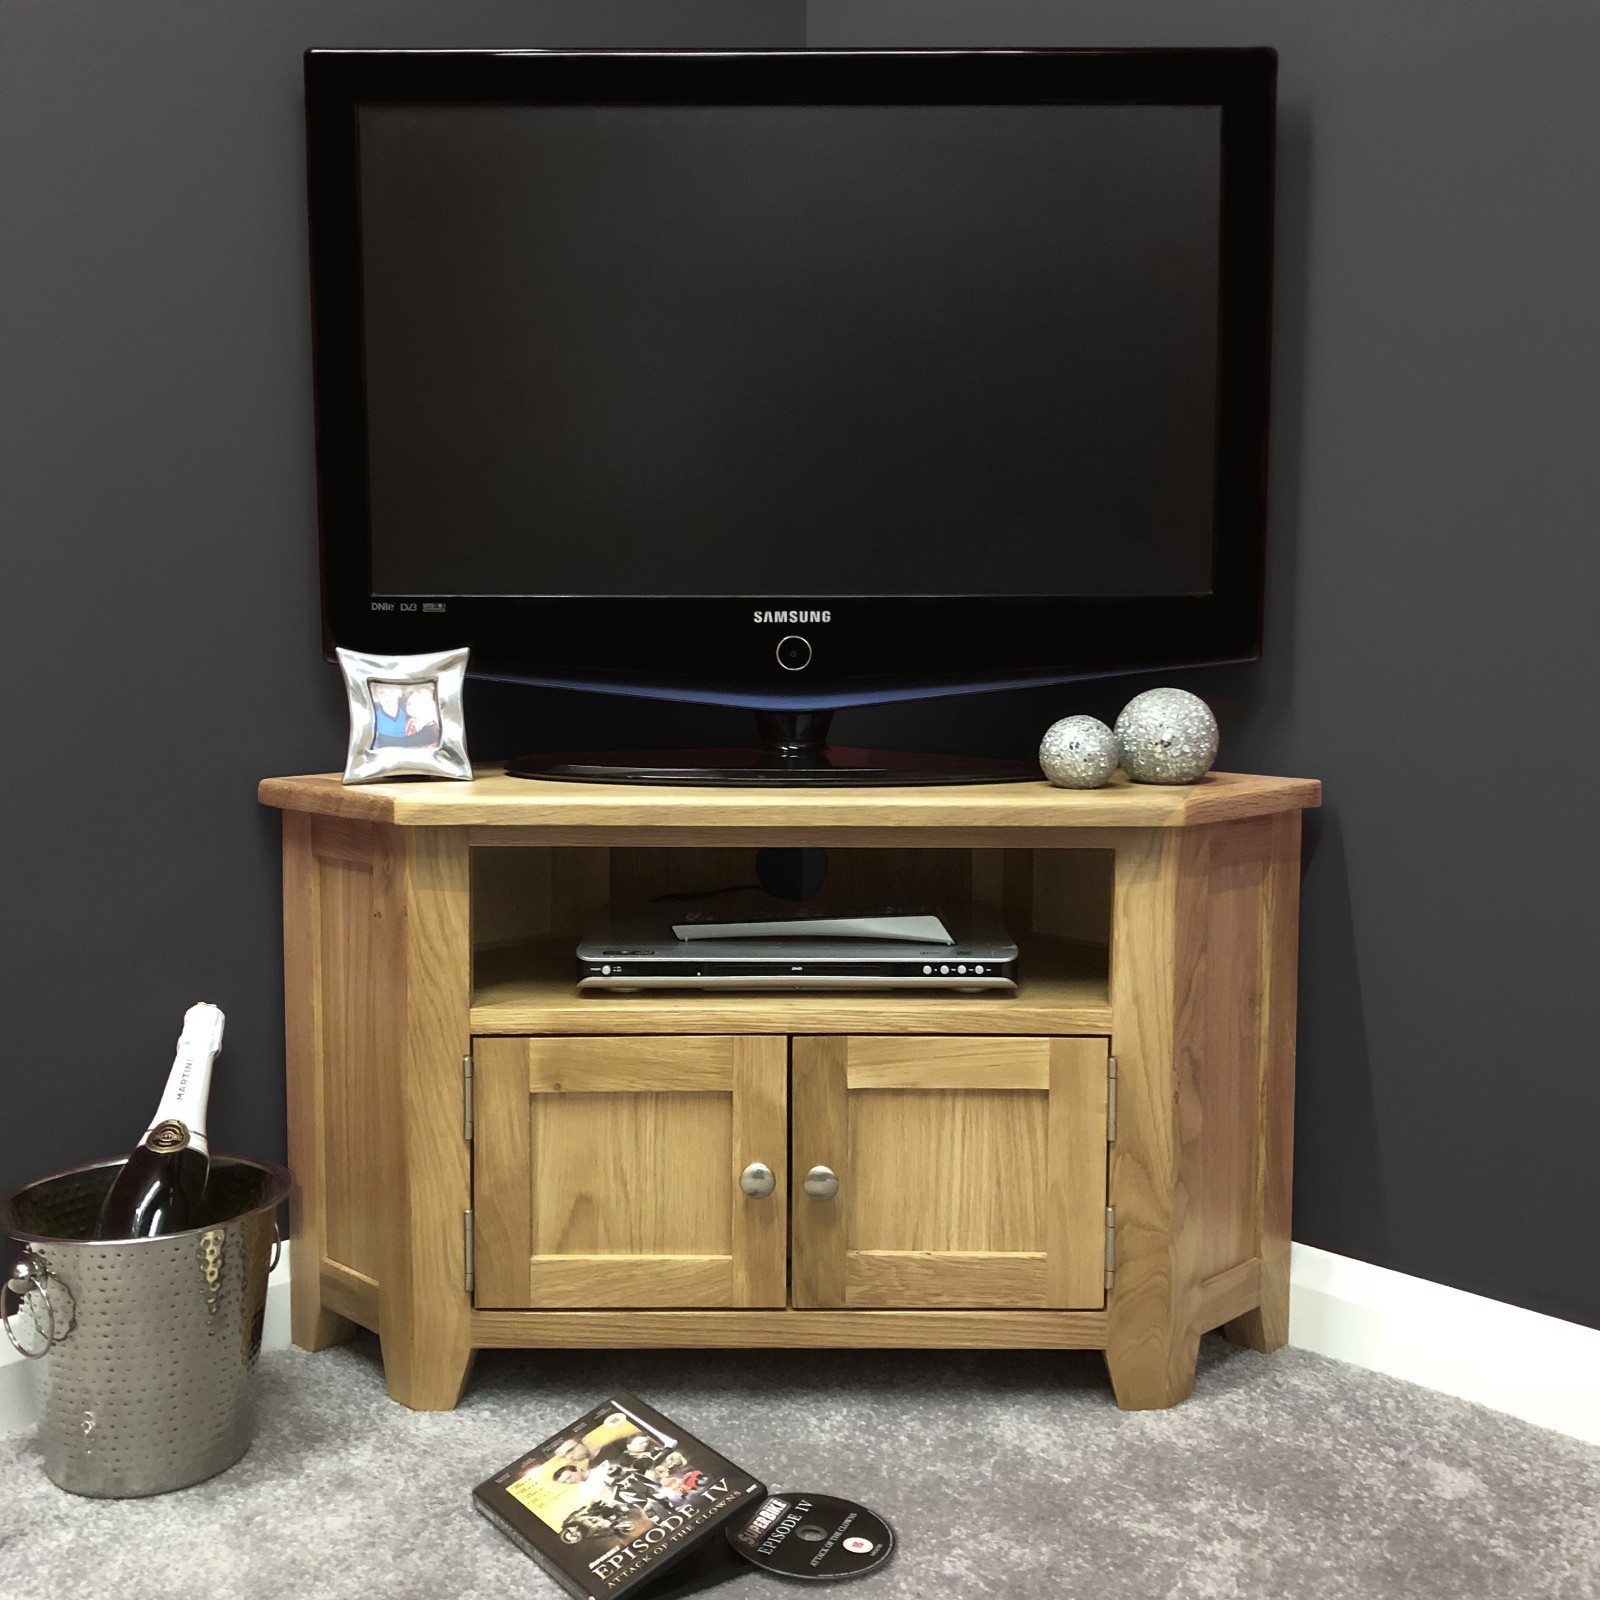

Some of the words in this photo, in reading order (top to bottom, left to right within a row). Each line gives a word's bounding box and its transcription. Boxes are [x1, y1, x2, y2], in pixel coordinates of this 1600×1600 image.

[753, 610, 831, 623] SAMSUNG
[176, 1058, 193, 1101] MARTINI
[591, 1504, 700, 1581] EPISODE
[701, 1478, 728, 1503] IV
[607, 1555, 652, 1589] ATTACK
[653, 1542, 669, 1555] OF
[670, 1524, 694, 1542] THE
[695, 1490, 742, 1525] CLOWNS
[737, 1498, 787, 1546] SUPERBIKE
[757, 1513, 803, 1556] EPISODE
[795, 1499, 814, 1512] IV
